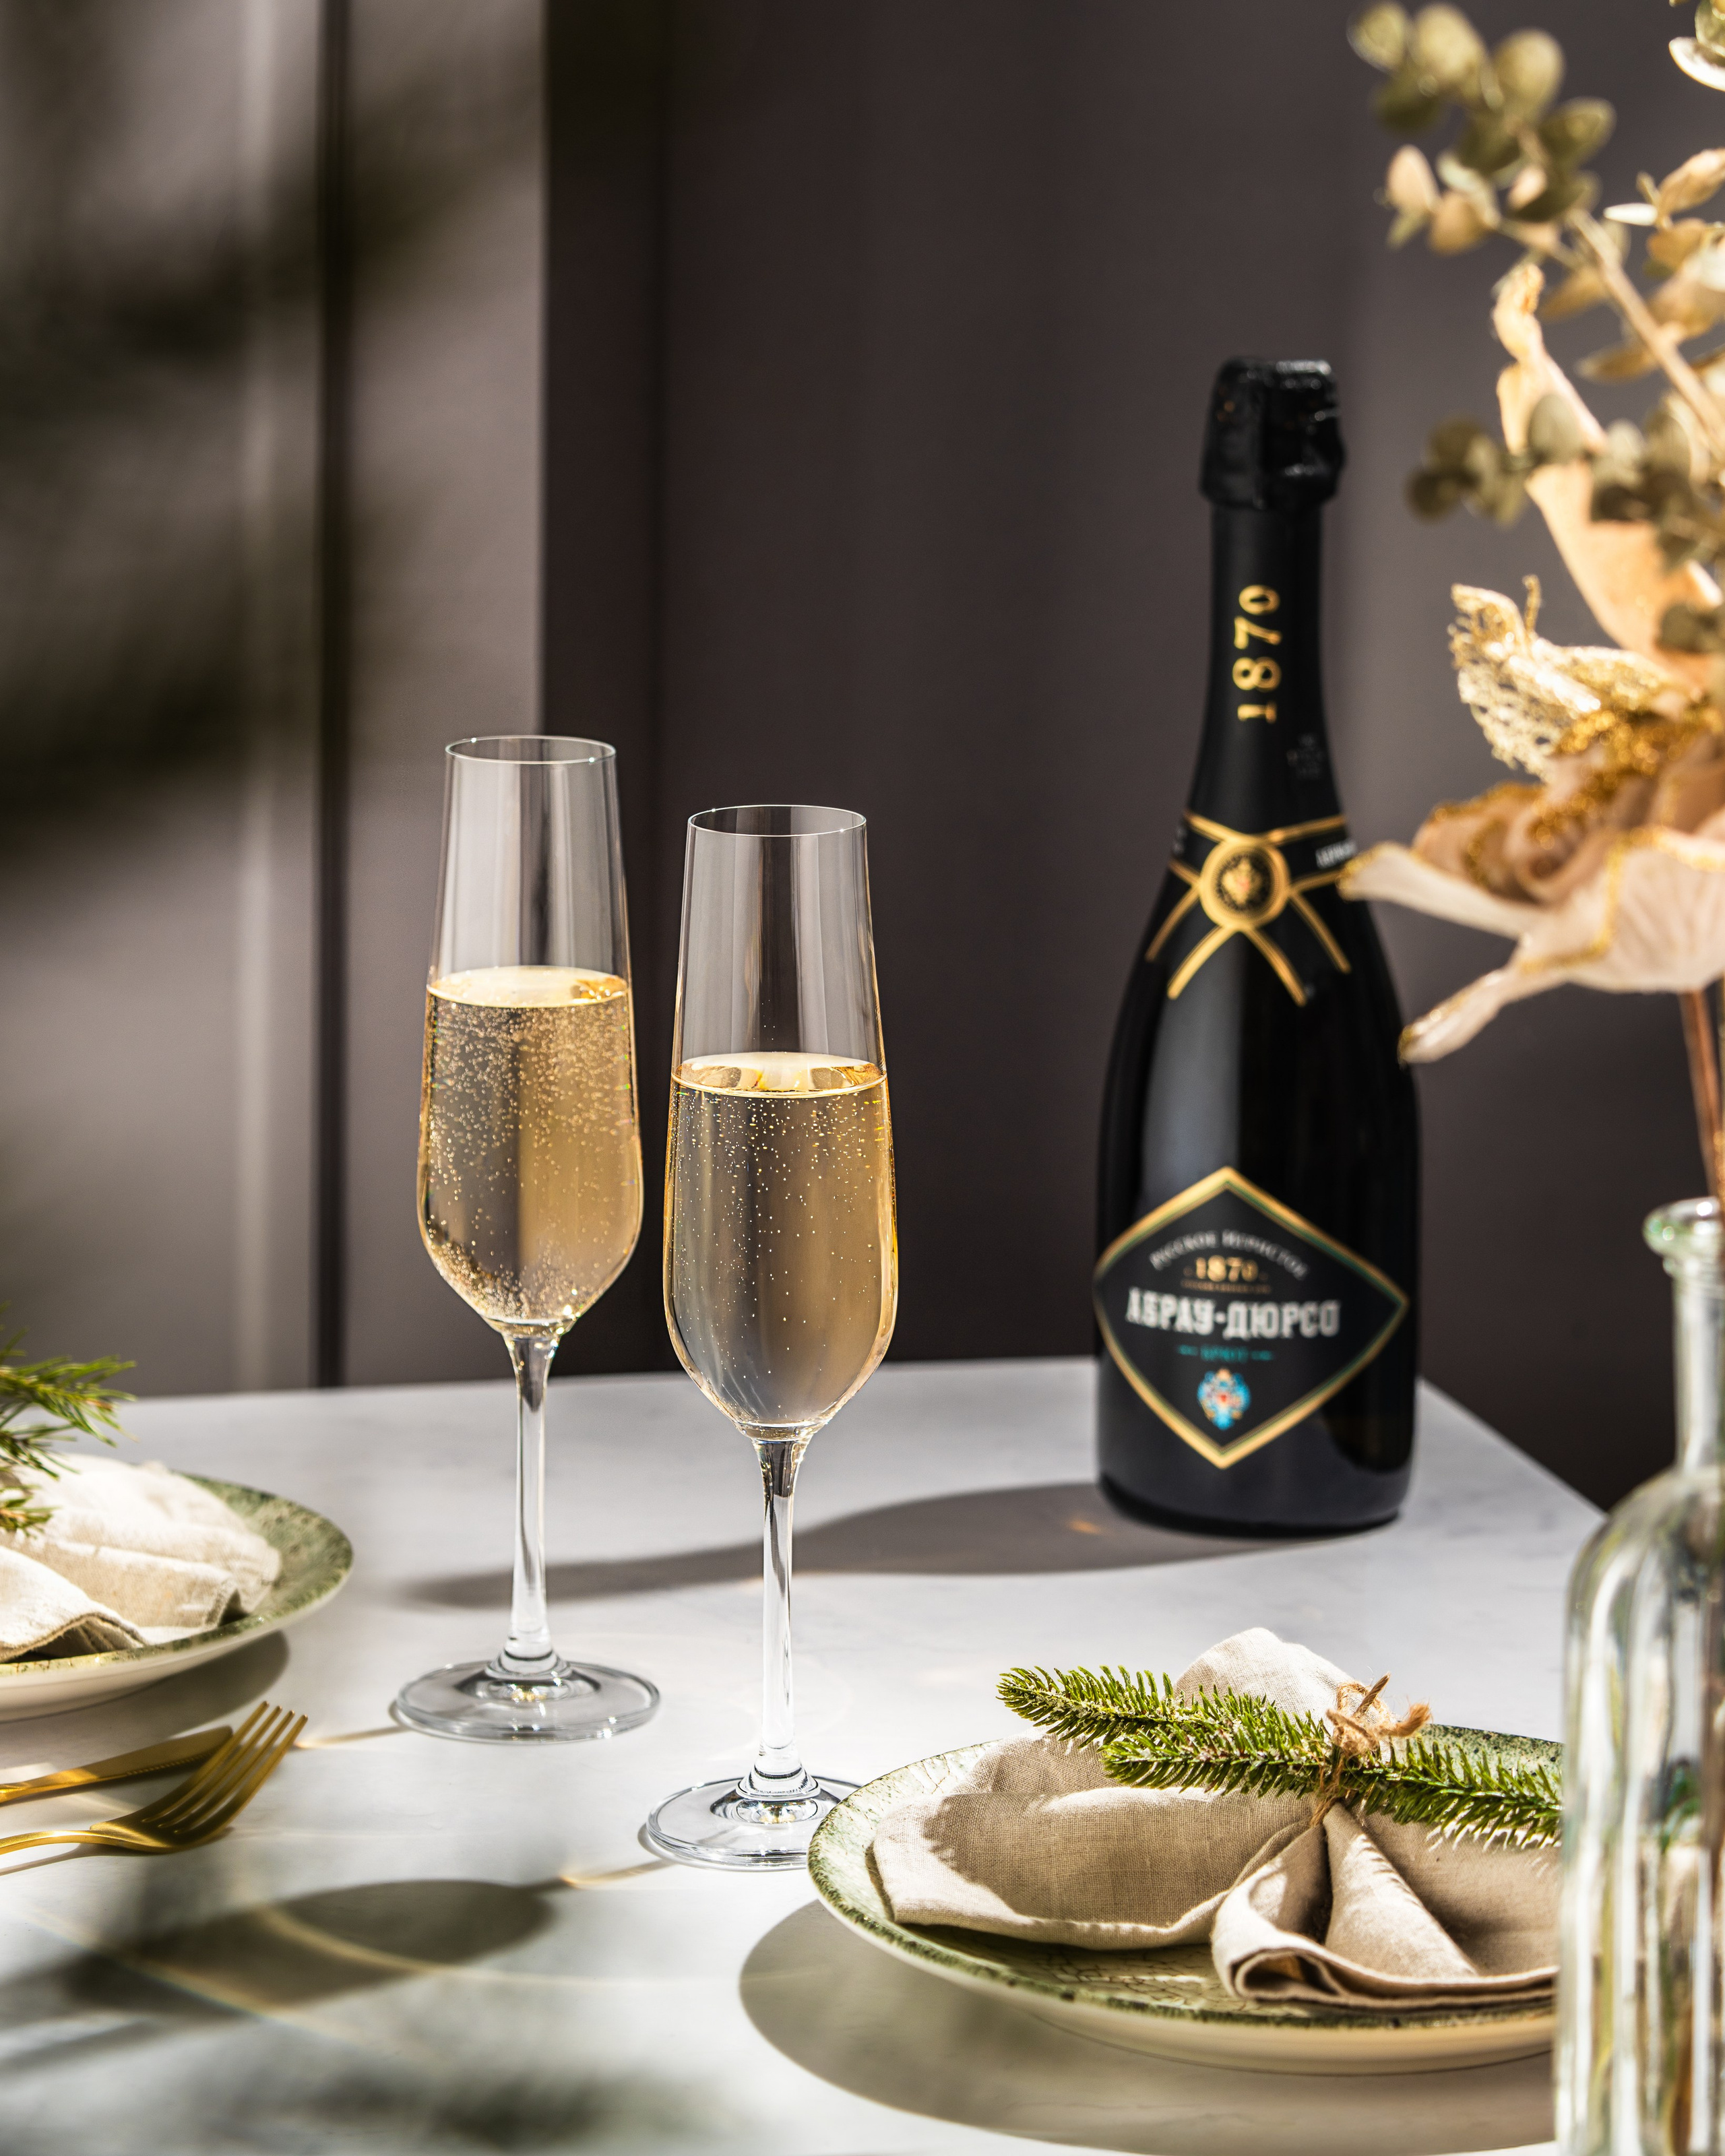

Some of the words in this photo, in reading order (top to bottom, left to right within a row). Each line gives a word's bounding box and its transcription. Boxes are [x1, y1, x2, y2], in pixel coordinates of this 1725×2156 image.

[1232, 585, 1281, 723] 1870
[1196, 1255, 1258, 1281] 1870
[1126, 1287, 1340, 1340] АБРАУ-ДЮРСО
